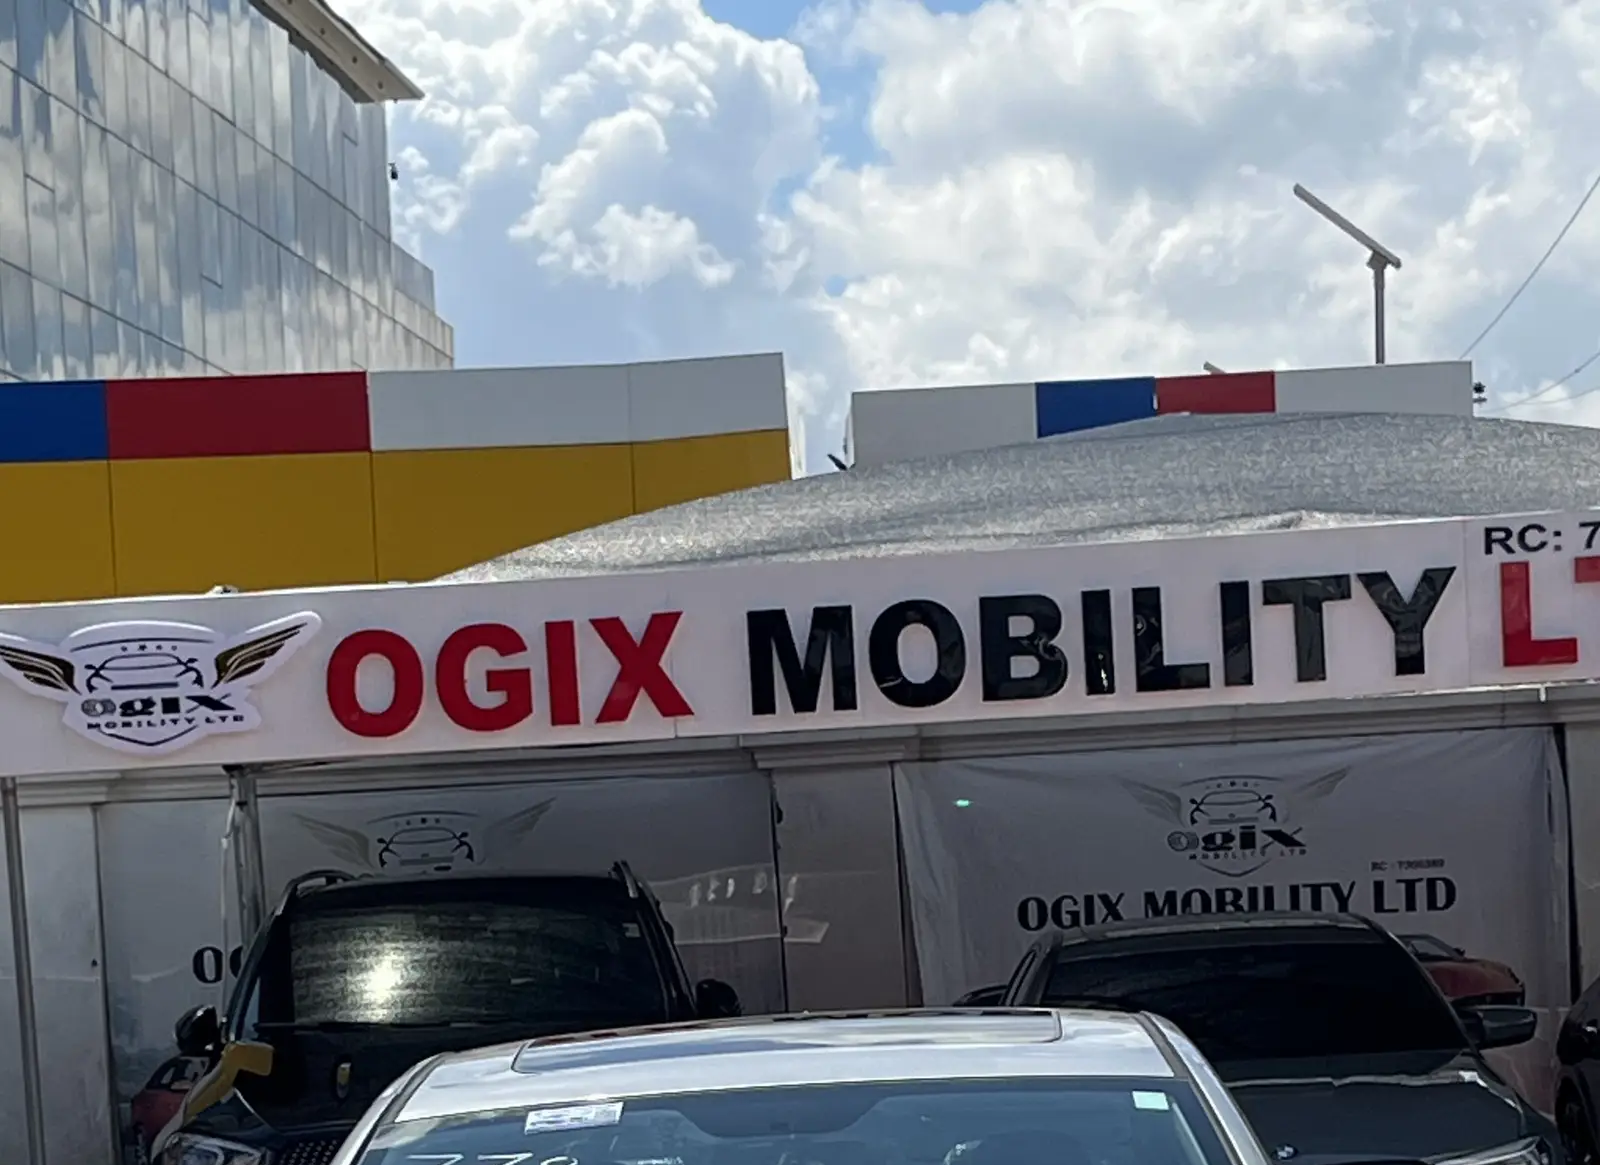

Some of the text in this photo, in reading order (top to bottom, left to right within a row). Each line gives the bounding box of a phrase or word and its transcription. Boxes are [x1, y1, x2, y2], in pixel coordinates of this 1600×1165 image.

[1484, 524, 1562, 555] RC:
[326, 611, 694, 737] OGIX
[747, 566, 1456, 714] MOBILITY
[1017, 877, 1456, 931] OGIX MOBILITY LTD
